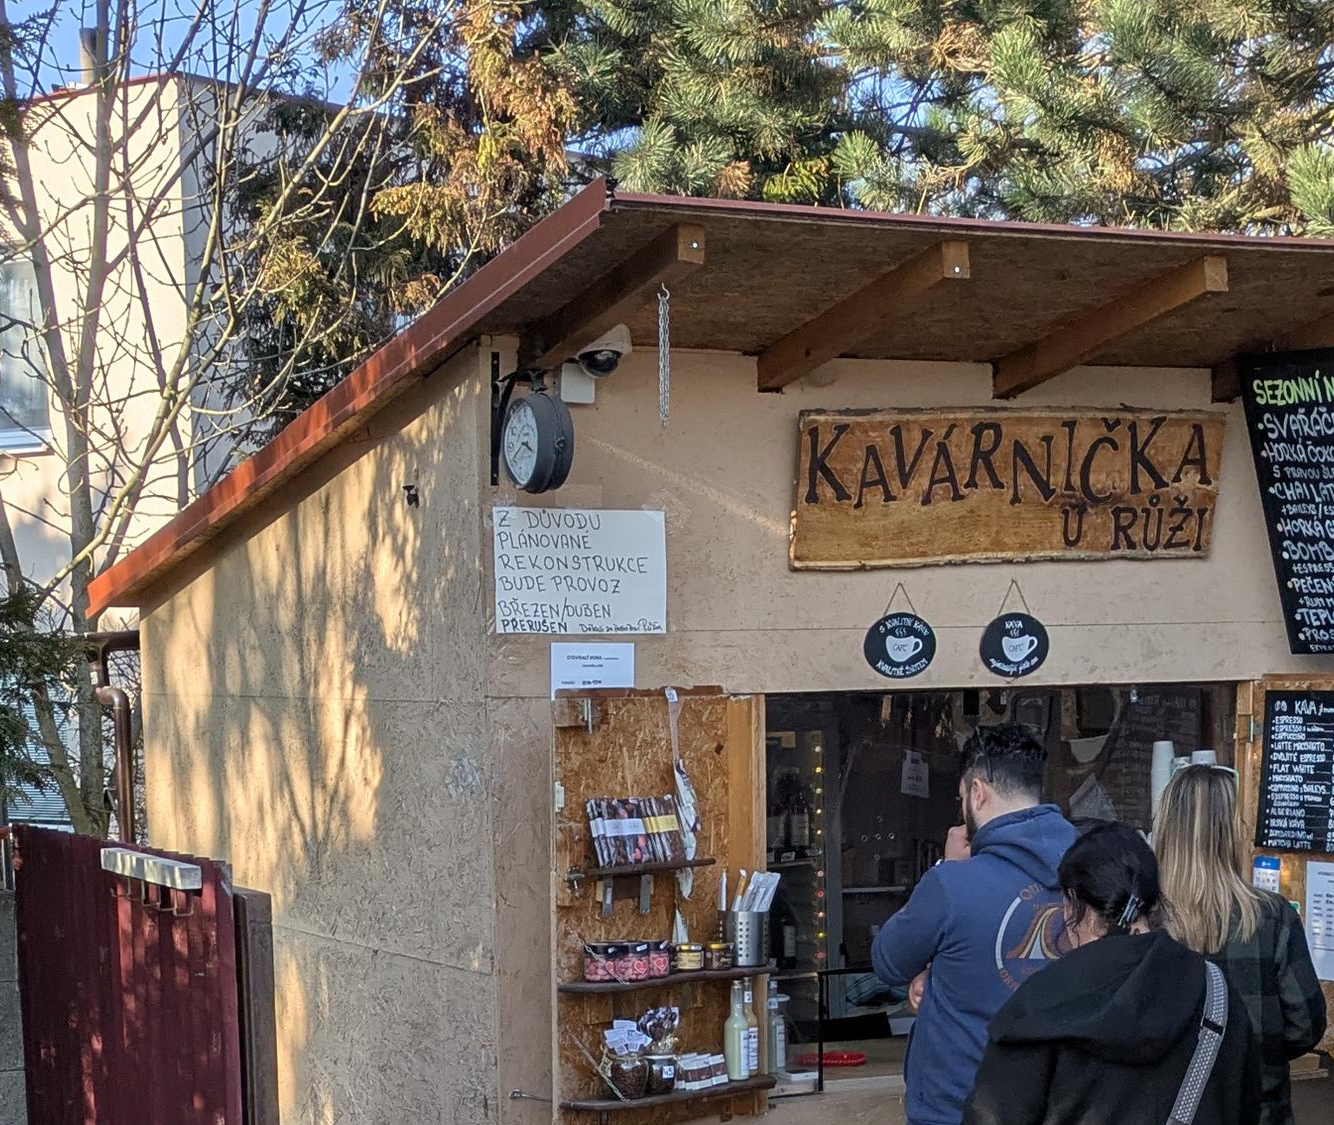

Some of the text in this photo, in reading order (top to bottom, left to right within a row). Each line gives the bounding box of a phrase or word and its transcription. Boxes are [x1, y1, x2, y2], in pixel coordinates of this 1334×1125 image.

[1253, 370, 1322, 405] SEZONNÍ
[1264, 438, 1307, 462] HORKÁ
[806, 416, 1211, 508] KAVÁRNIČKA
[1275, 482, 1310, 500] CHAI
[497, 509, 601, 530] Z DŮVODU
[1062, 495, 1208, 551] U RŮŽI
[1281, 516, 1325, 537] HORKÁ
[497, 530, 591, 549] PLÁNOVANÉ
[498, 553, 648, 573] REKONSTRUKCE
[499, 575, 620, 594] BUDE PROVOZ
[502, 616, 567, 632] PŘERUŠEN
[1273, 764, 1290, 773] FLAT
[1292, 764, 1315, 774] WHITE
